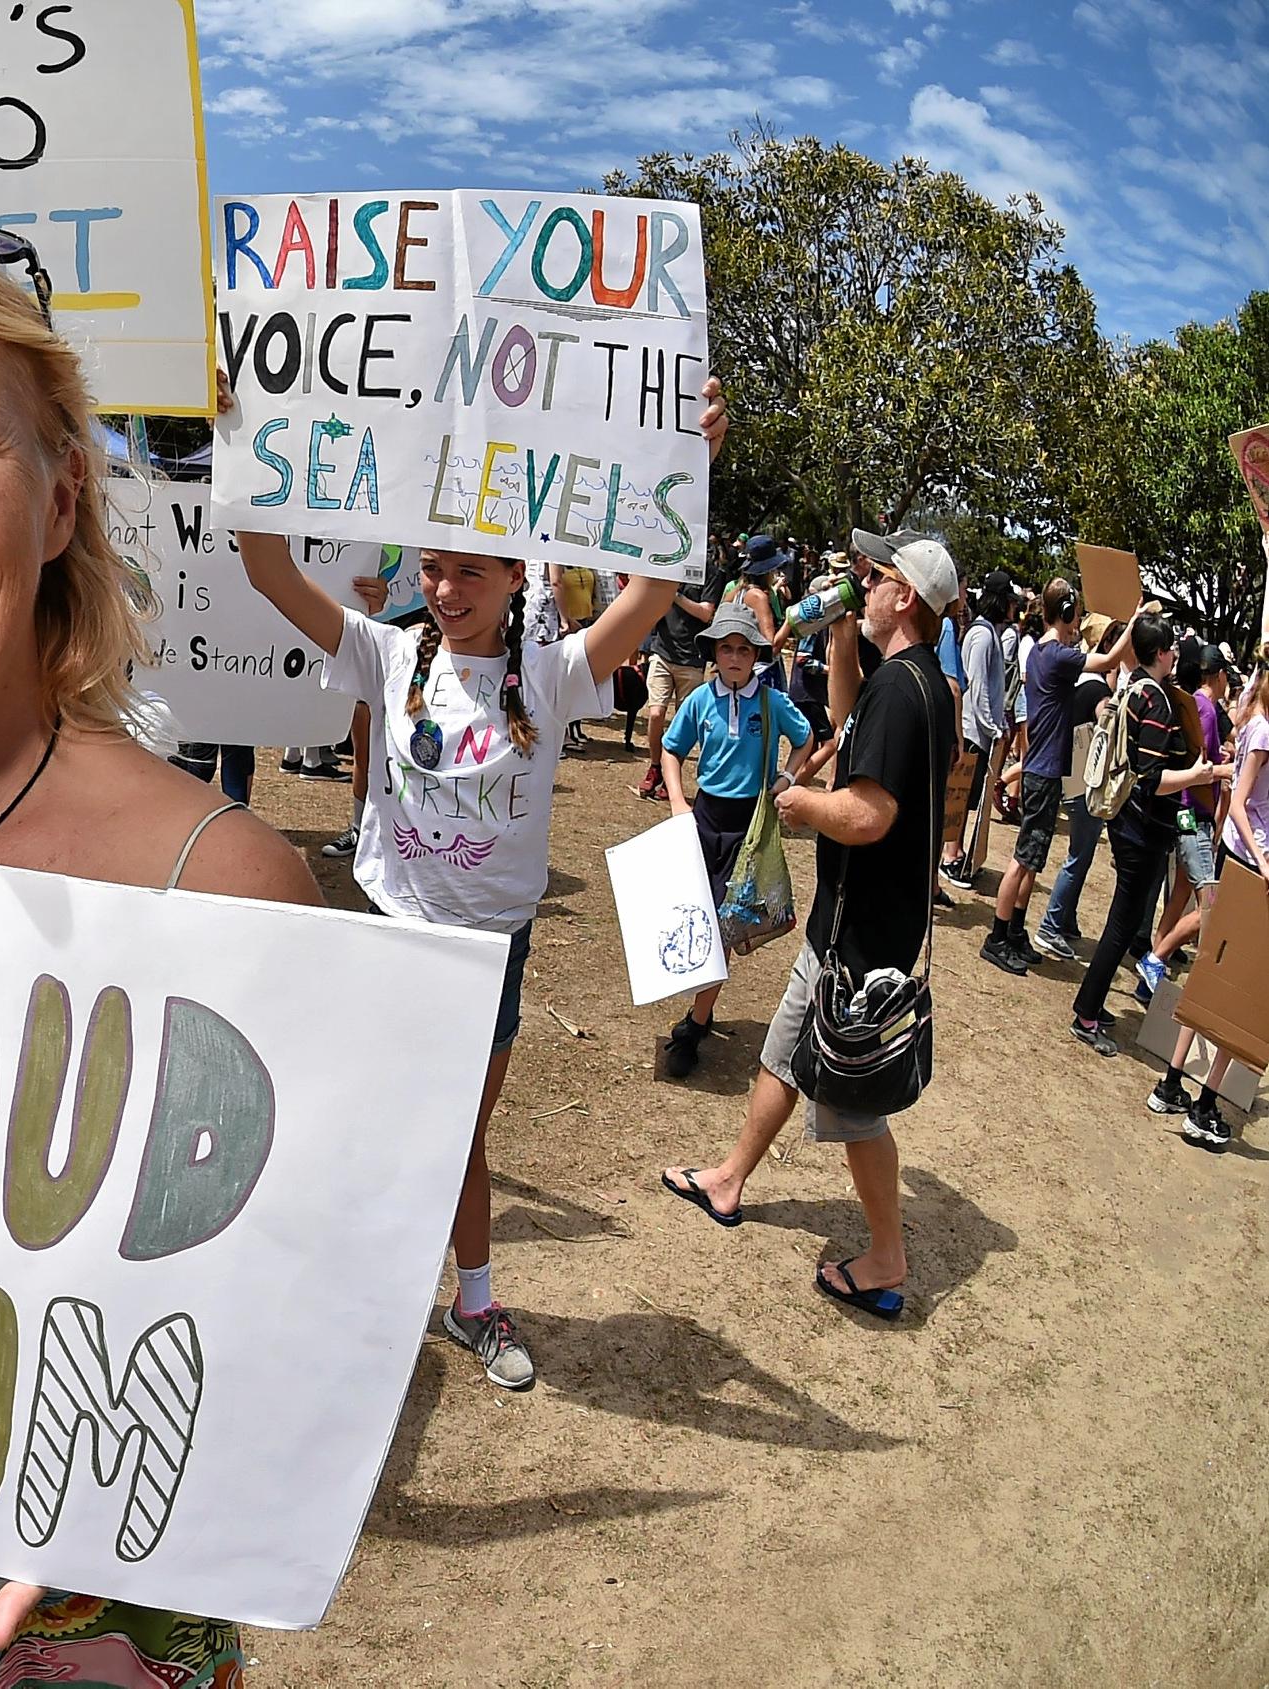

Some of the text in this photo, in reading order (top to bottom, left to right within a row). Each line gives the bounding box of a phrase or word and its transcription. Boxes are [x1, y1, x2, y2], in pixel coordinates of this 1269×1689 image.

[223, 199, 692, 317] RAISE YOUR
[219, 311, 703, 438] VOICE, NOT THE
[251, 415, 694, 567] SEA LEVELS
[106, 500, 156, 546] hat
[171, 503, 215, 554] We
[178, 571, 211, 611] is
[190, 636, 275, 678] Stand
[385, 756, 530, 821] STRIKE
